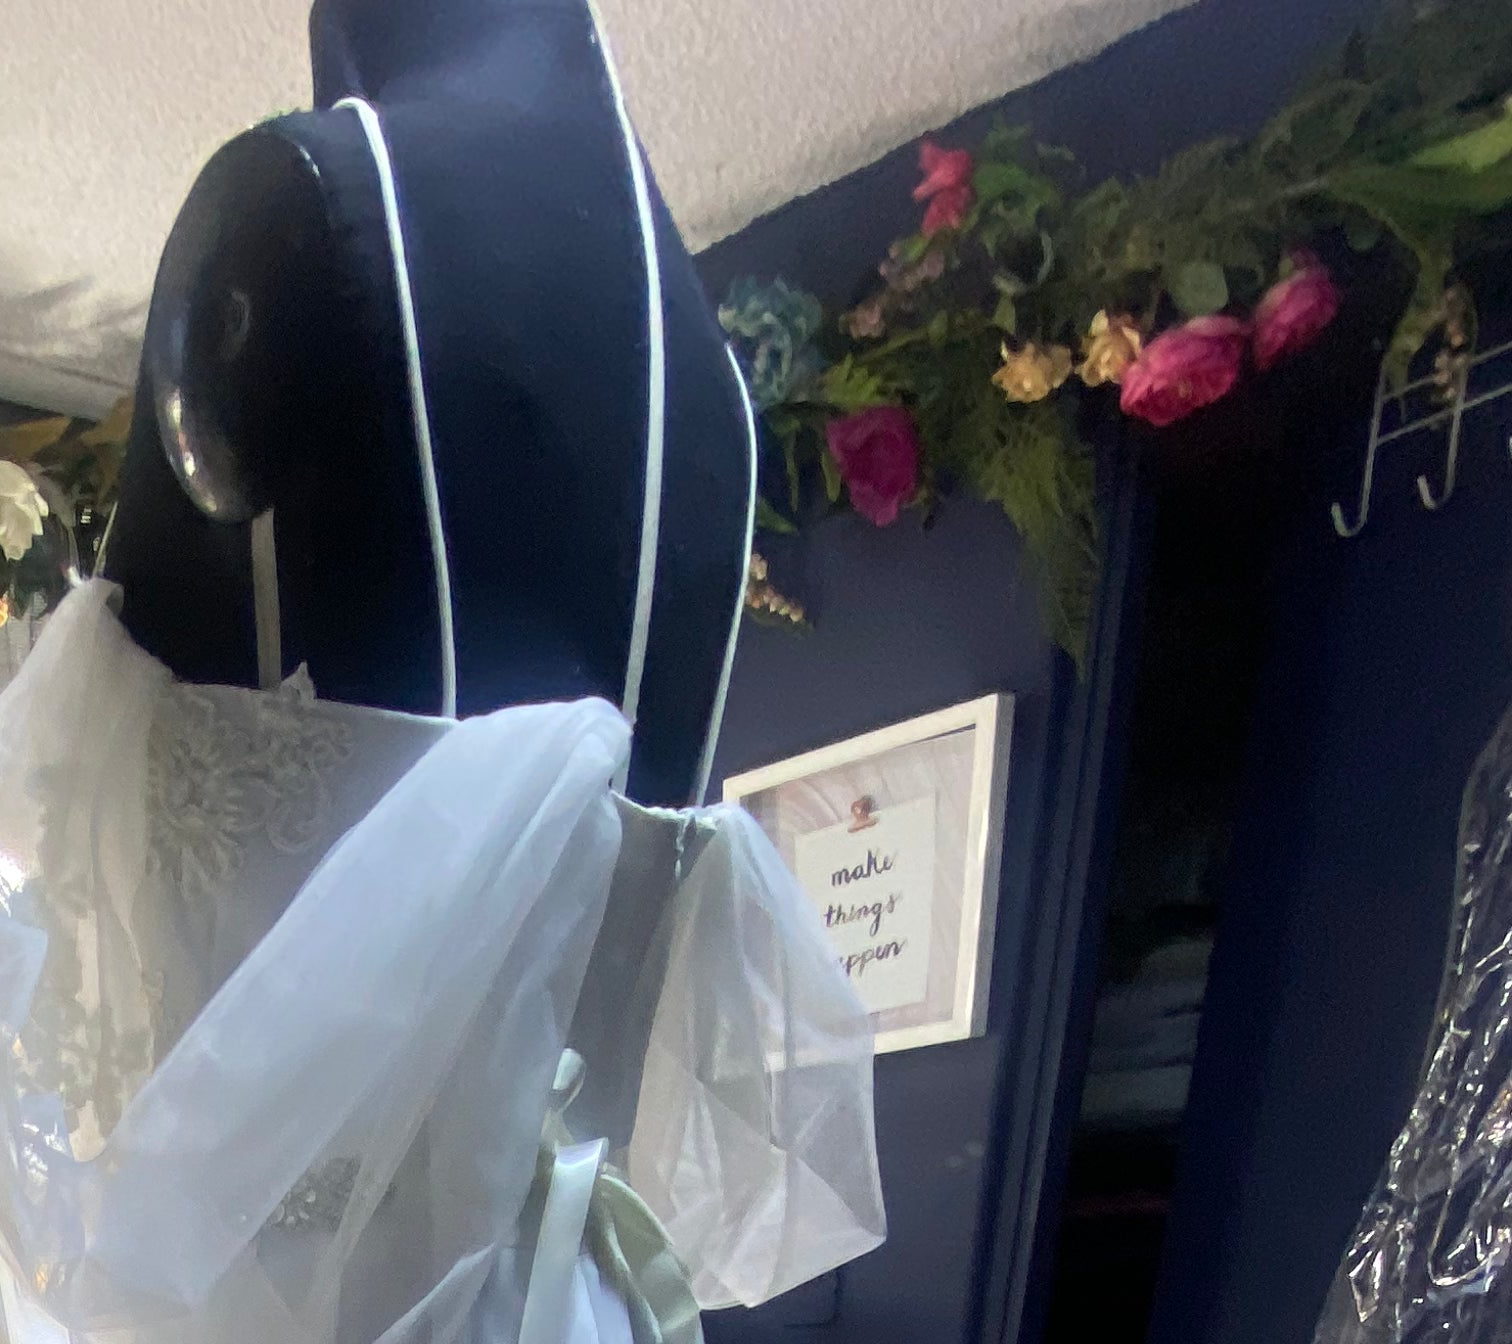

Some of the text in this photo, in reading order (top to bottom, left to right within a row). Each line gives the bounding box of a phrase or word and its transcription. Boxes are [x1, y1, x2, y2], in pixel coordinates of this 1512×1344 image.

[831, 849, 895, 887] make
[824, 893, 900, 937] things
[839, 940, 906, 977] ppen
